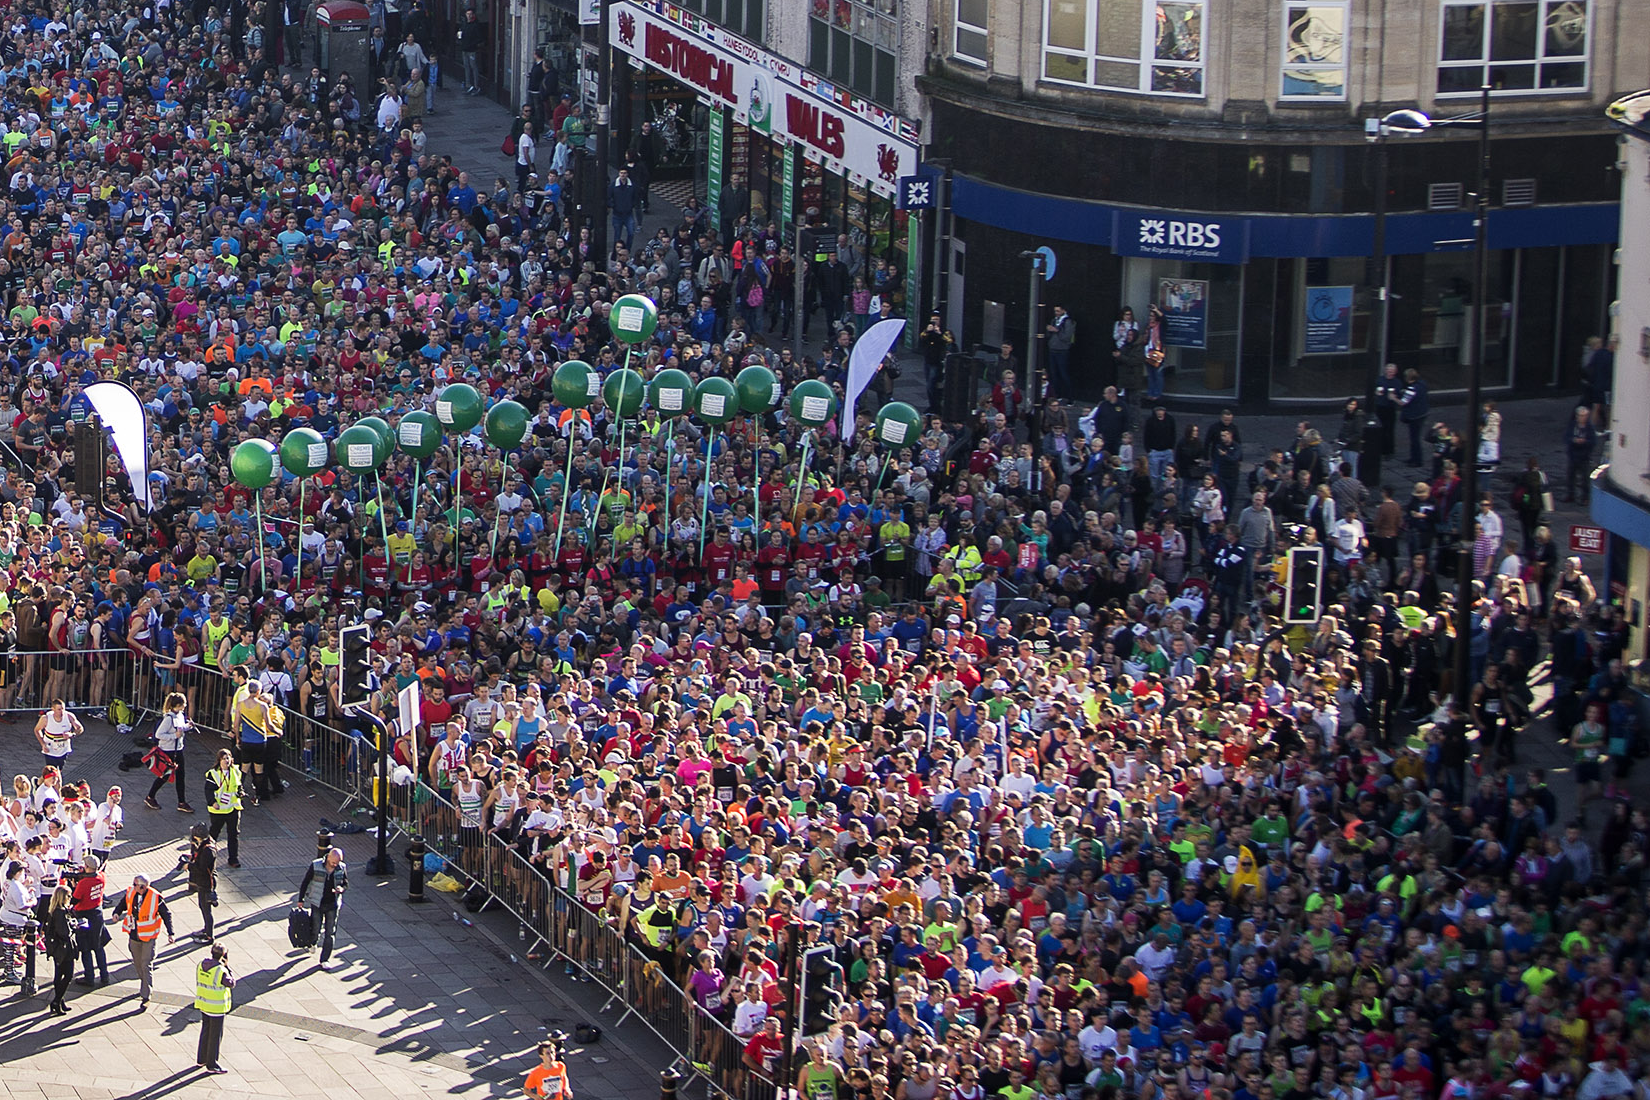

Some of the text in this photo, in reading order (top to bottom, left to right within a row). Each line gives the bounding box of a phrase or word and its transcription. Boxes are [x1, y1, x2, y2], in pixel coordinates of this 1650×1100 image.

[645, 21, 738, 104] HISTORICAL
[723, 35, 791, 77] HANESYDDOL CYMRU
[785, 93, 845, 159] WALES
[1168, 221, 1221, 248] RBS
[1573, 527, 1602, 538] JUST
[1579, 537, 1600, 549] EAT
